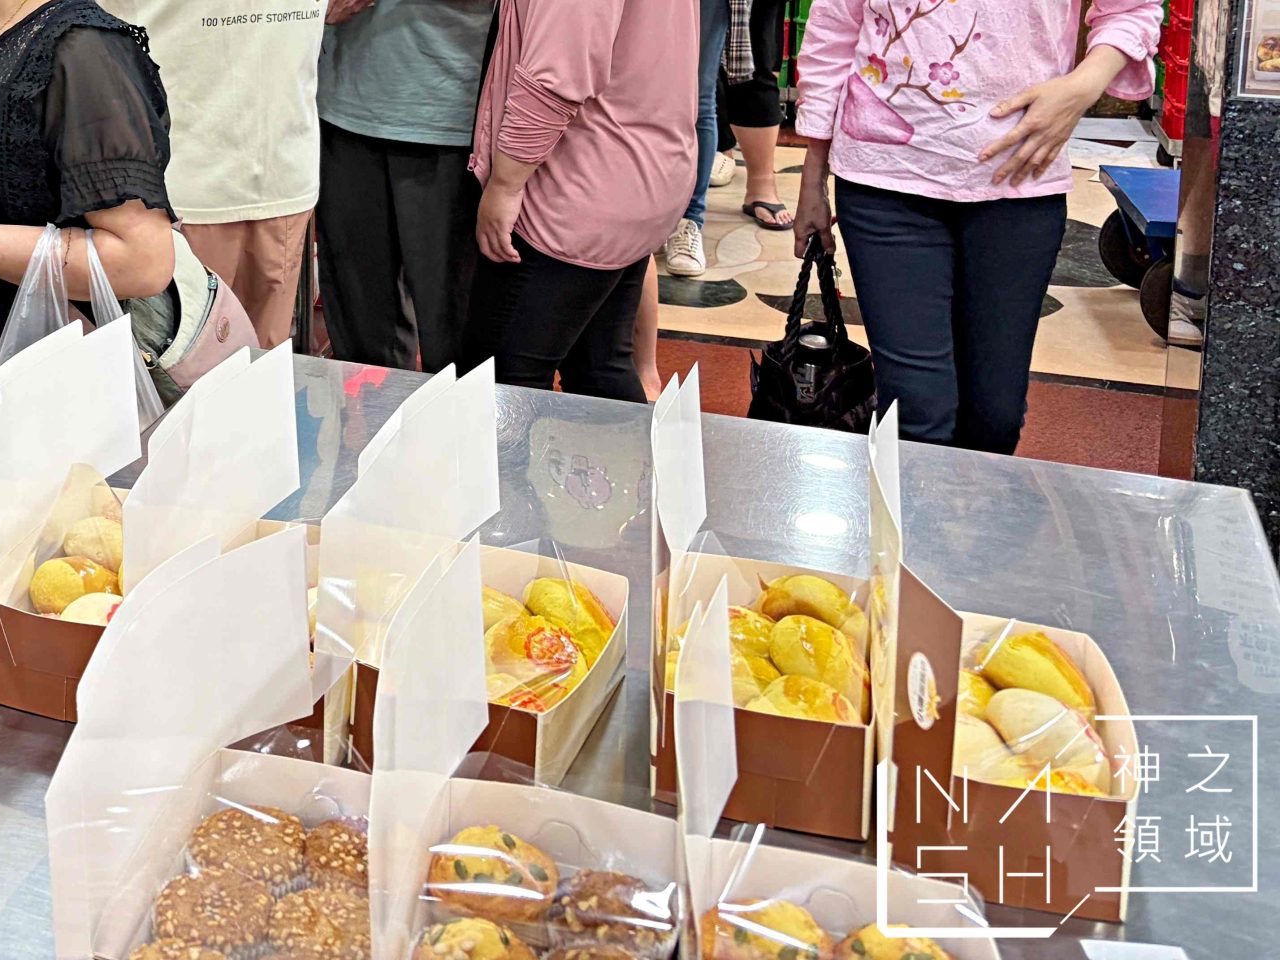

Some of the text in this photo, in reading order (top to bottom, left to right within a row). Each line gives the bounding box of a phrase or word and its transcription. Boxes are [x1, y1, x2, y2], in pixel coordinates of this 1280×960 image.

[201, 9, 320, 27] 100 YEARS OF STORYTELLING
